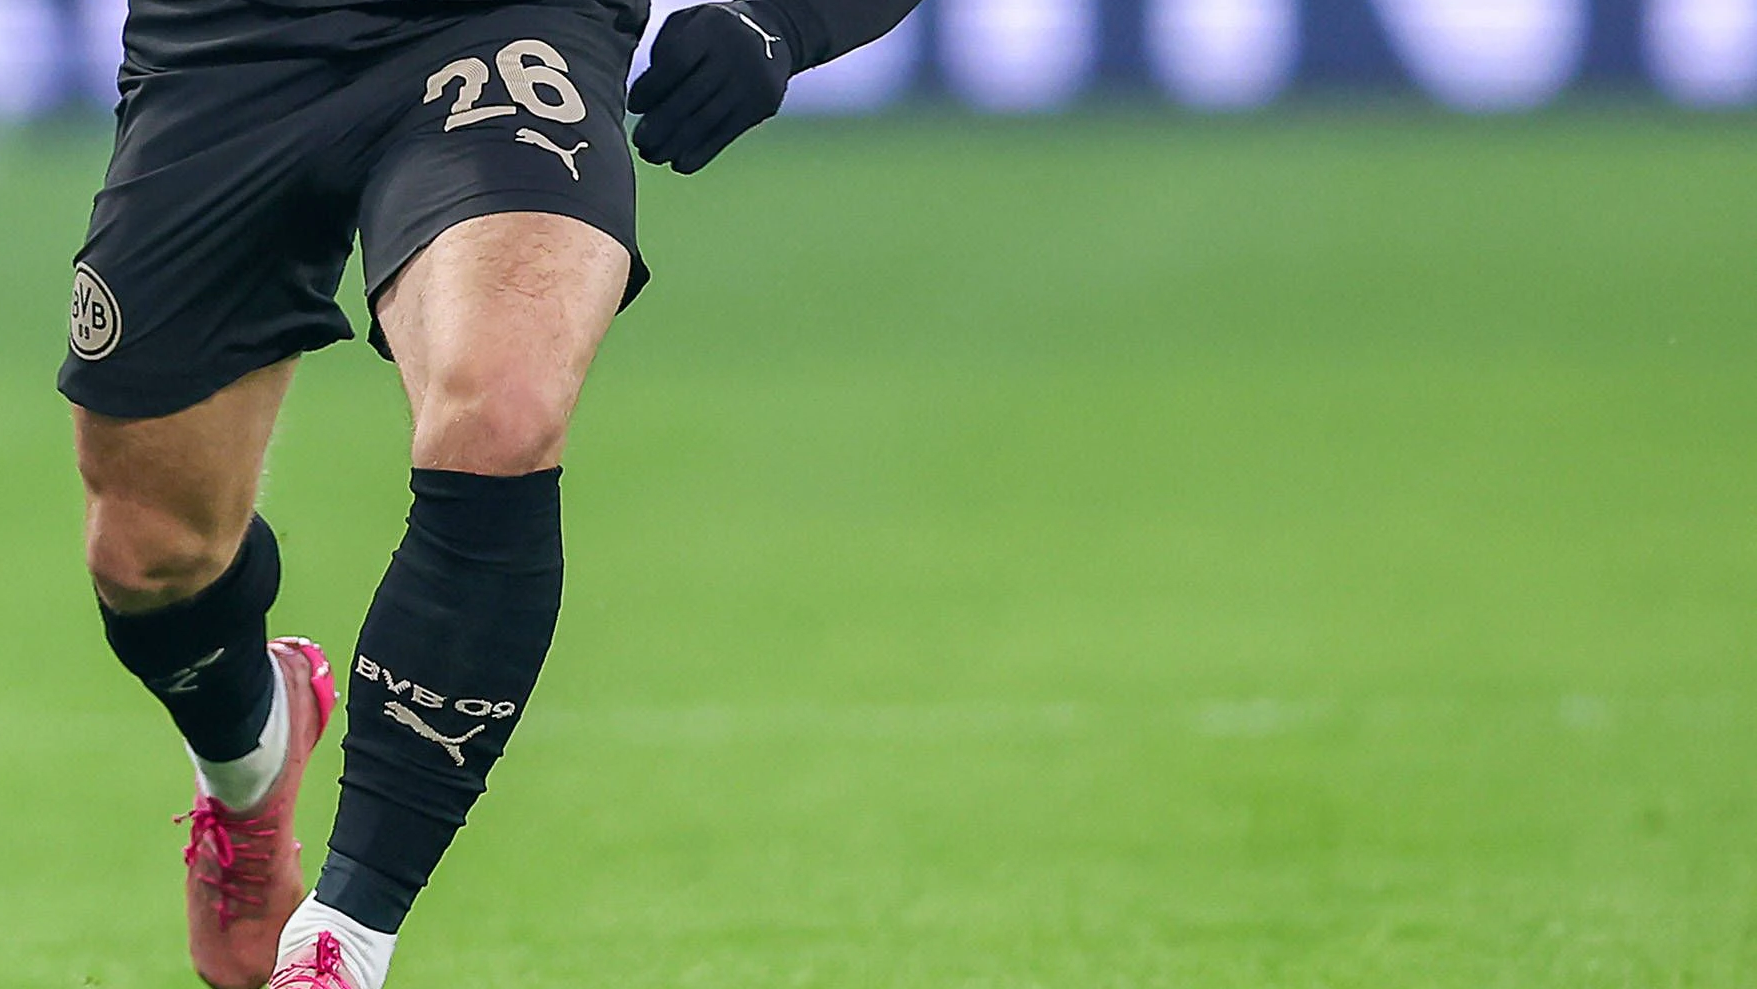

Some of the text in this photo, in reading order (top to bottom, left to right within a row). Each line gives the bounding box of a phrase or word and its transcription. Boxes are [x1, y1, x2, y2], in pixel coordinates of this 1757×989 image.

[422, 39, 587, 132] 26
[355, 654, 516, 719] BVB 09
